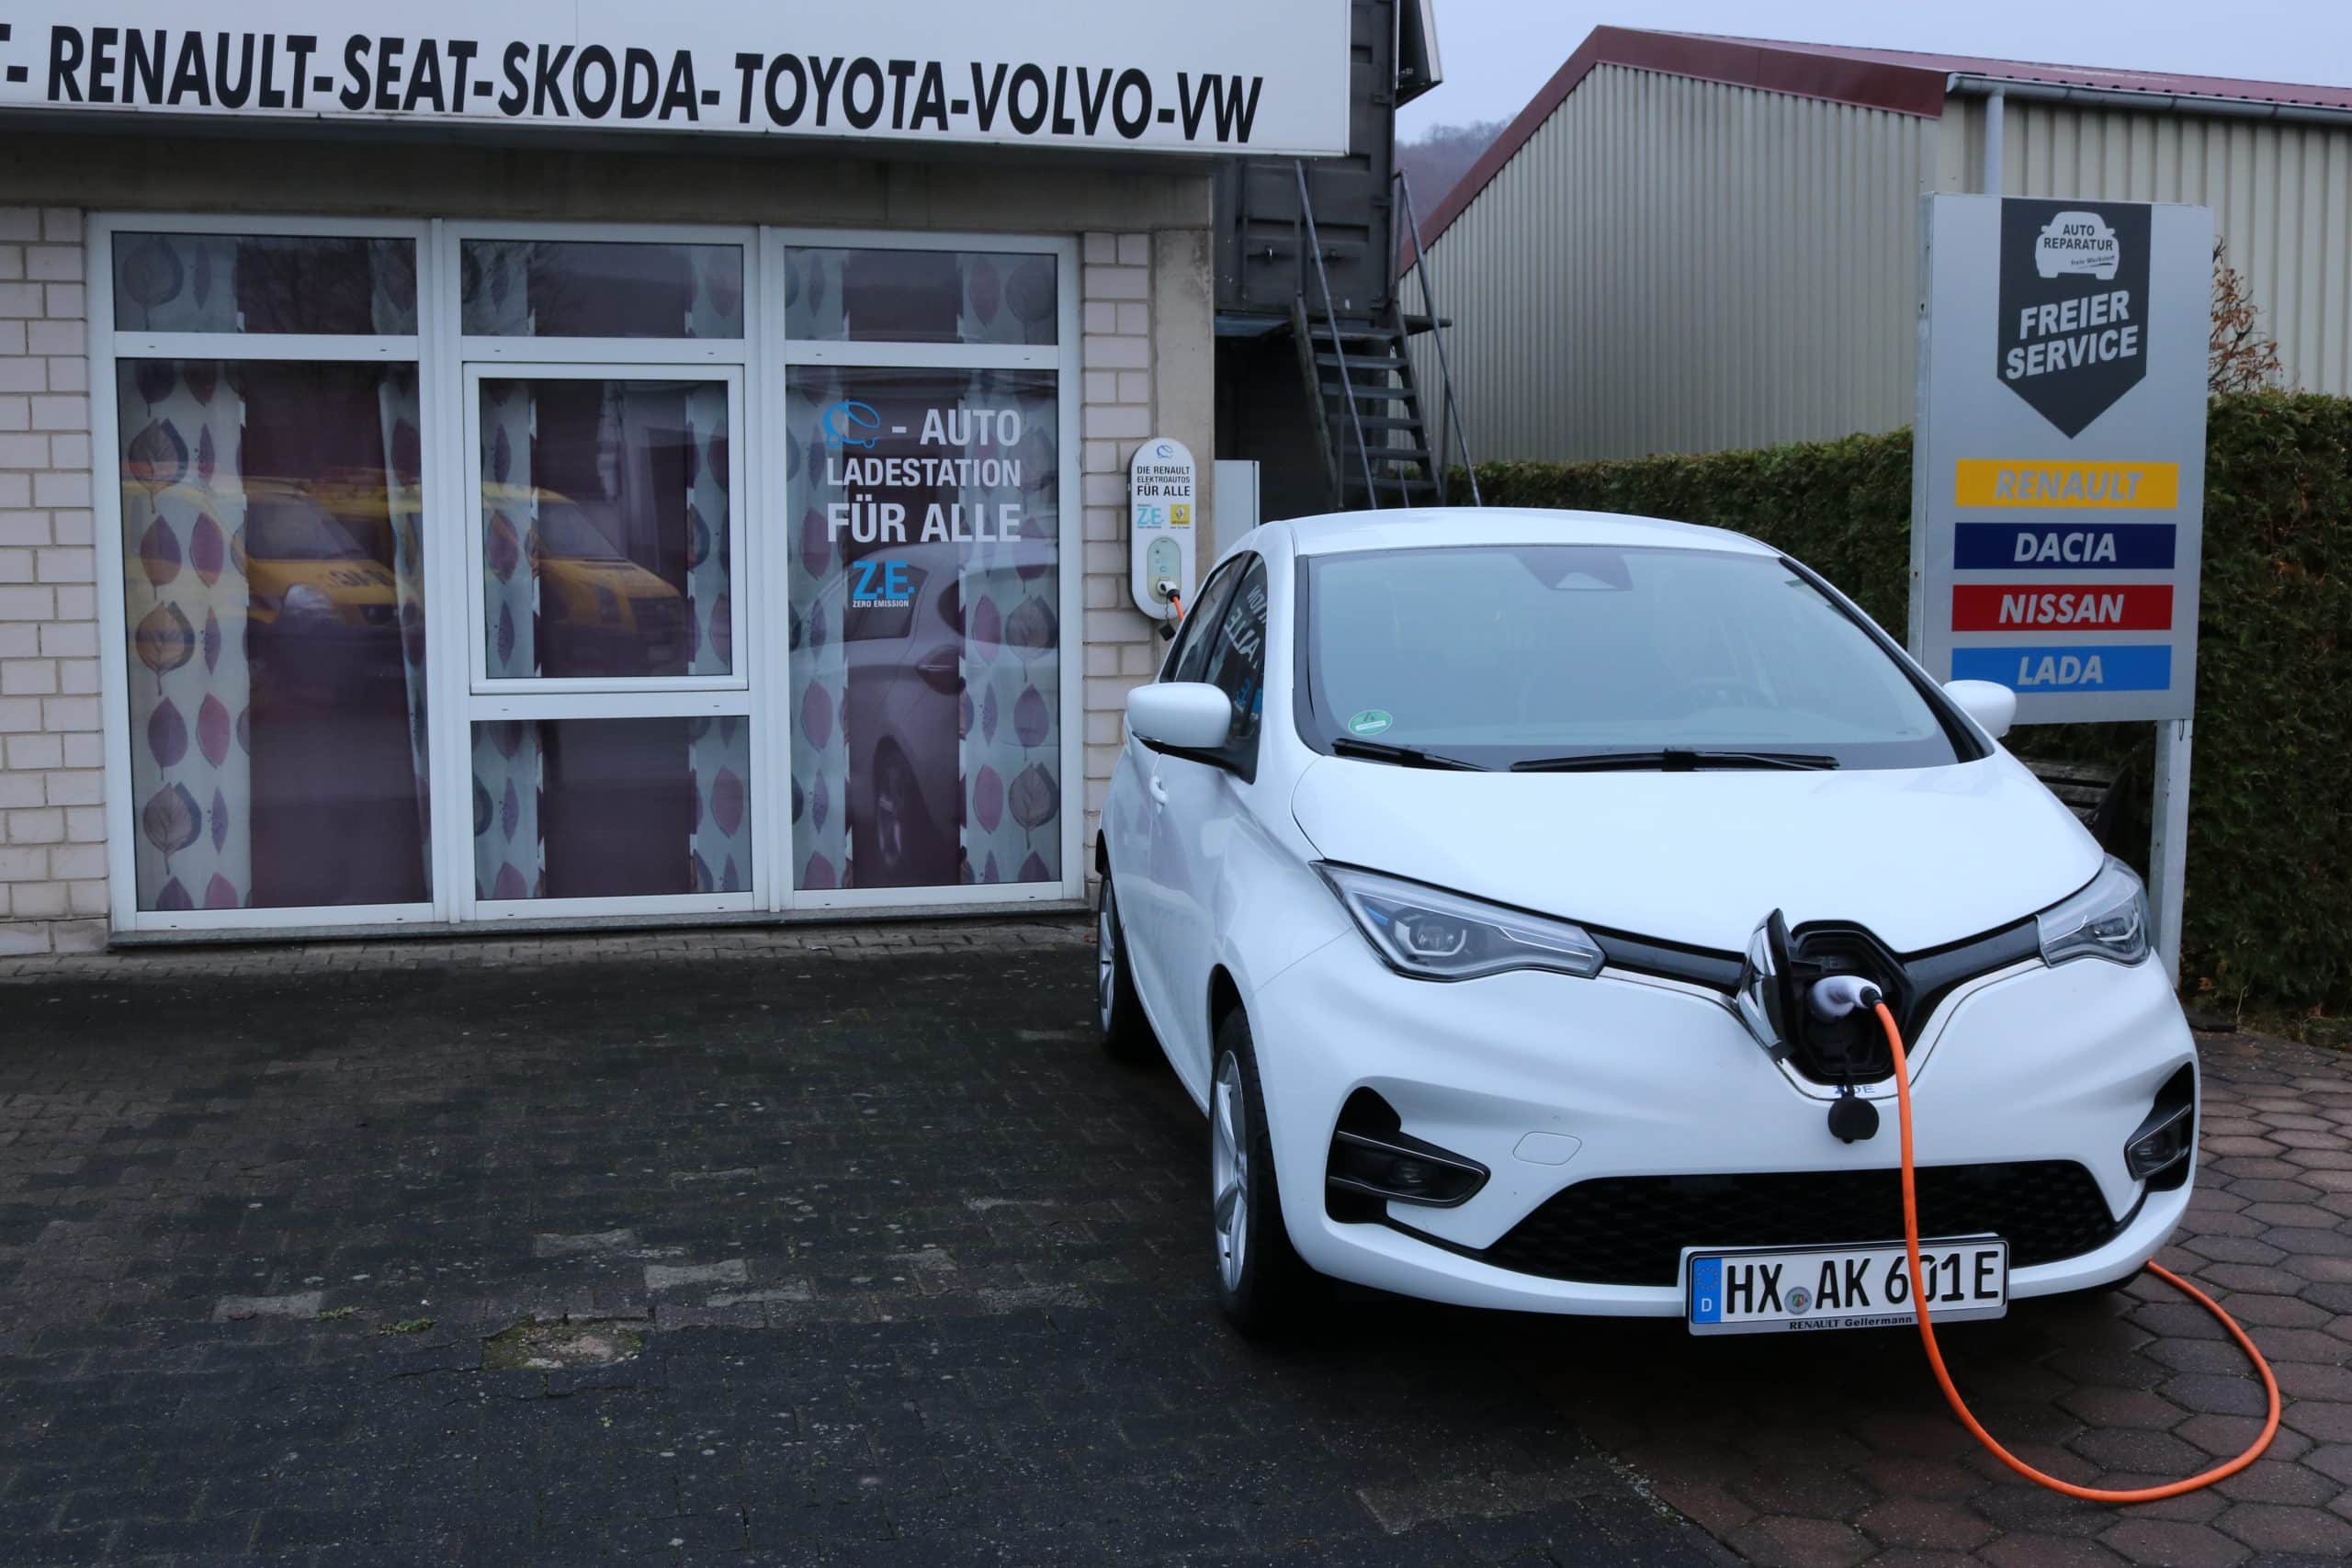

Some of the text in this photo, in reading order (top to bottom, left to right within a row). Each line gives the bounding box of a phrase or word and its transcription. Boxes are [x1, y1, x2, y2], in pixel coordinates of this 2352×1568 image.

[2043, 237, 2113, 251] REPARATUR
[2063, 224, 2095, 236] AUTO
[2019, 290, 2131, 340] FREIER
[2006, 325, 2139, 379] SERVICE
[920, 409, 1022, 446] AUTO
[827, 457, 1022, 487] LADESTATION
[1136, 465, 1191, 475] DIE RENAULT
[1995, 469, 2144, 501] RENAULT
[1137, 482, 1191, 496] FÜR ALLE
[827, 493, 1022, 543] FÜR ALLE
[2013, 533, 2117, 563] DACIA
[853, 559, 915, 600] Z.E.
[852, 599, 910, 608] ZERO EMISSION
[1998, 594, 2125, 625] NISSAN
[2017, 655, 2104, 685] LADA
[1726, 1250, 1999, 1314] HX AK 601E
[1702, 1298, 1713, 1313] D
[1789, 1315, 1912, 1330] RENAULT Gellermann
